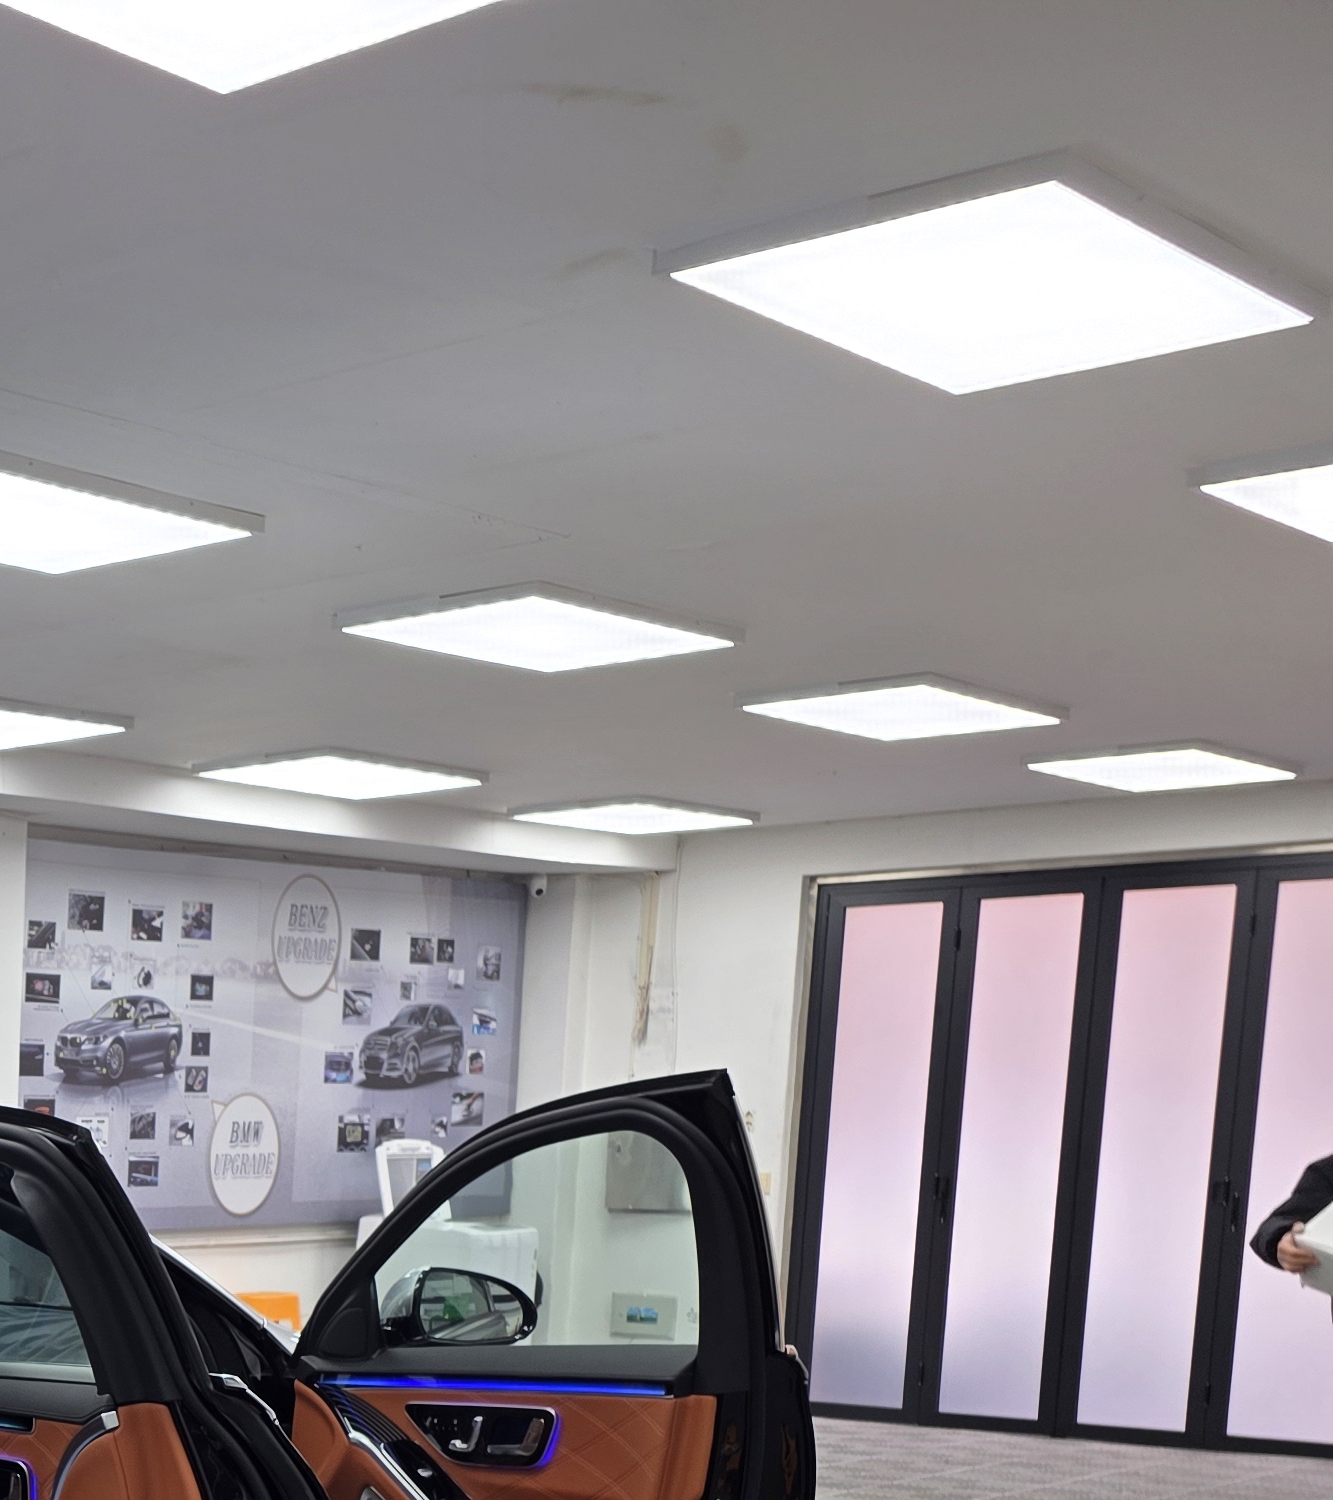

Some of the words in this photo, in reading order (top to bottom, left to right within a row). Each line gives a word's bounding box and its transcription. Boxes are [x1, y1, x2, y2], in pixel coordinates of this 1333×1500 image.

[288, 903, 329, 931] BENZ
[277, 935, 337, 963] UPGRADE
[229, 1121, 265, 1146] BMW
[213, 1152, 276, 1178] UPGRADE
